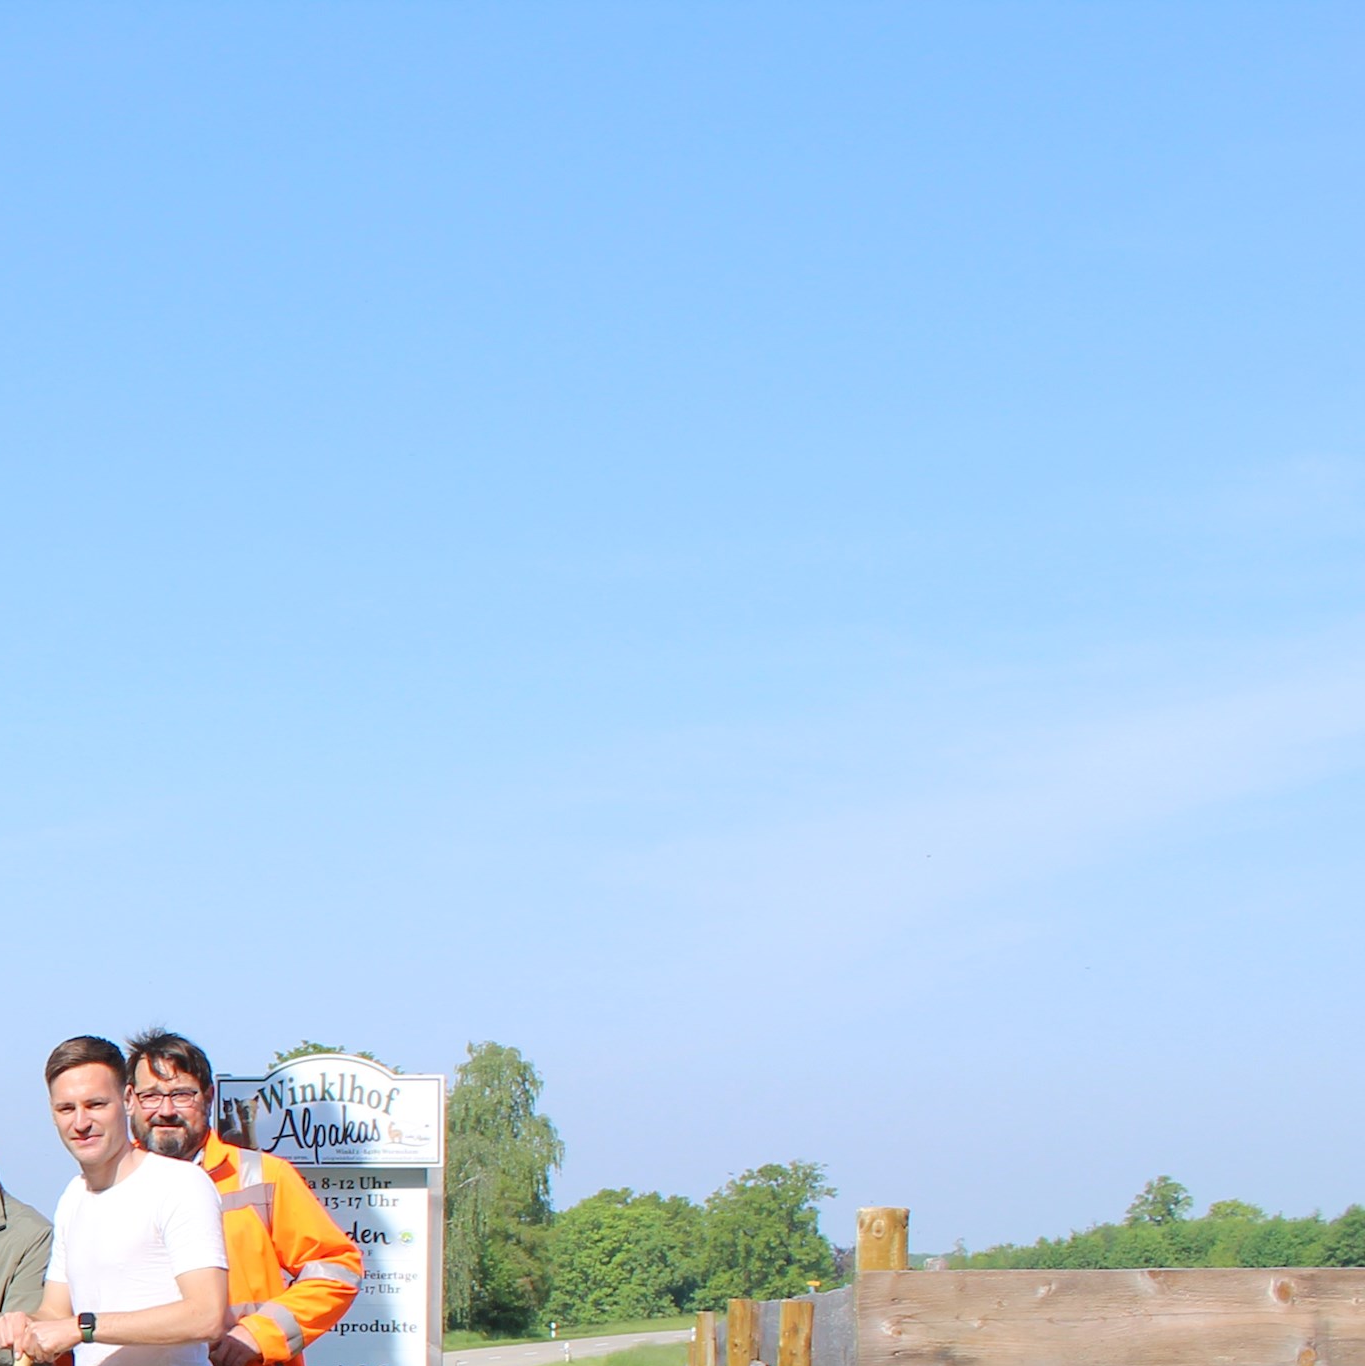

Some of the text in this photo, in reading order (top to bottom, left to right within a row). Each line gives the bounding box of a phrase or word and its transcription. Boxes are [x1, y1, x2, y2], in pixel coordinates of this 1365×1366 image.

[258, 1073, 400, 1115] Winklhof
[261, 1105, 381, 1164] Alpakas
[321, 1177, 355, 1190] 8-12
[359, 1177, 392, 1190] Uhr
[324, 1194, 399, 1210] 13-17 Uhr
[345, 1221, 391, 1245] den
[363, 1270, 418, 1283] Feiertage
[360, 1284, 401, 1295] -17 Uhr
